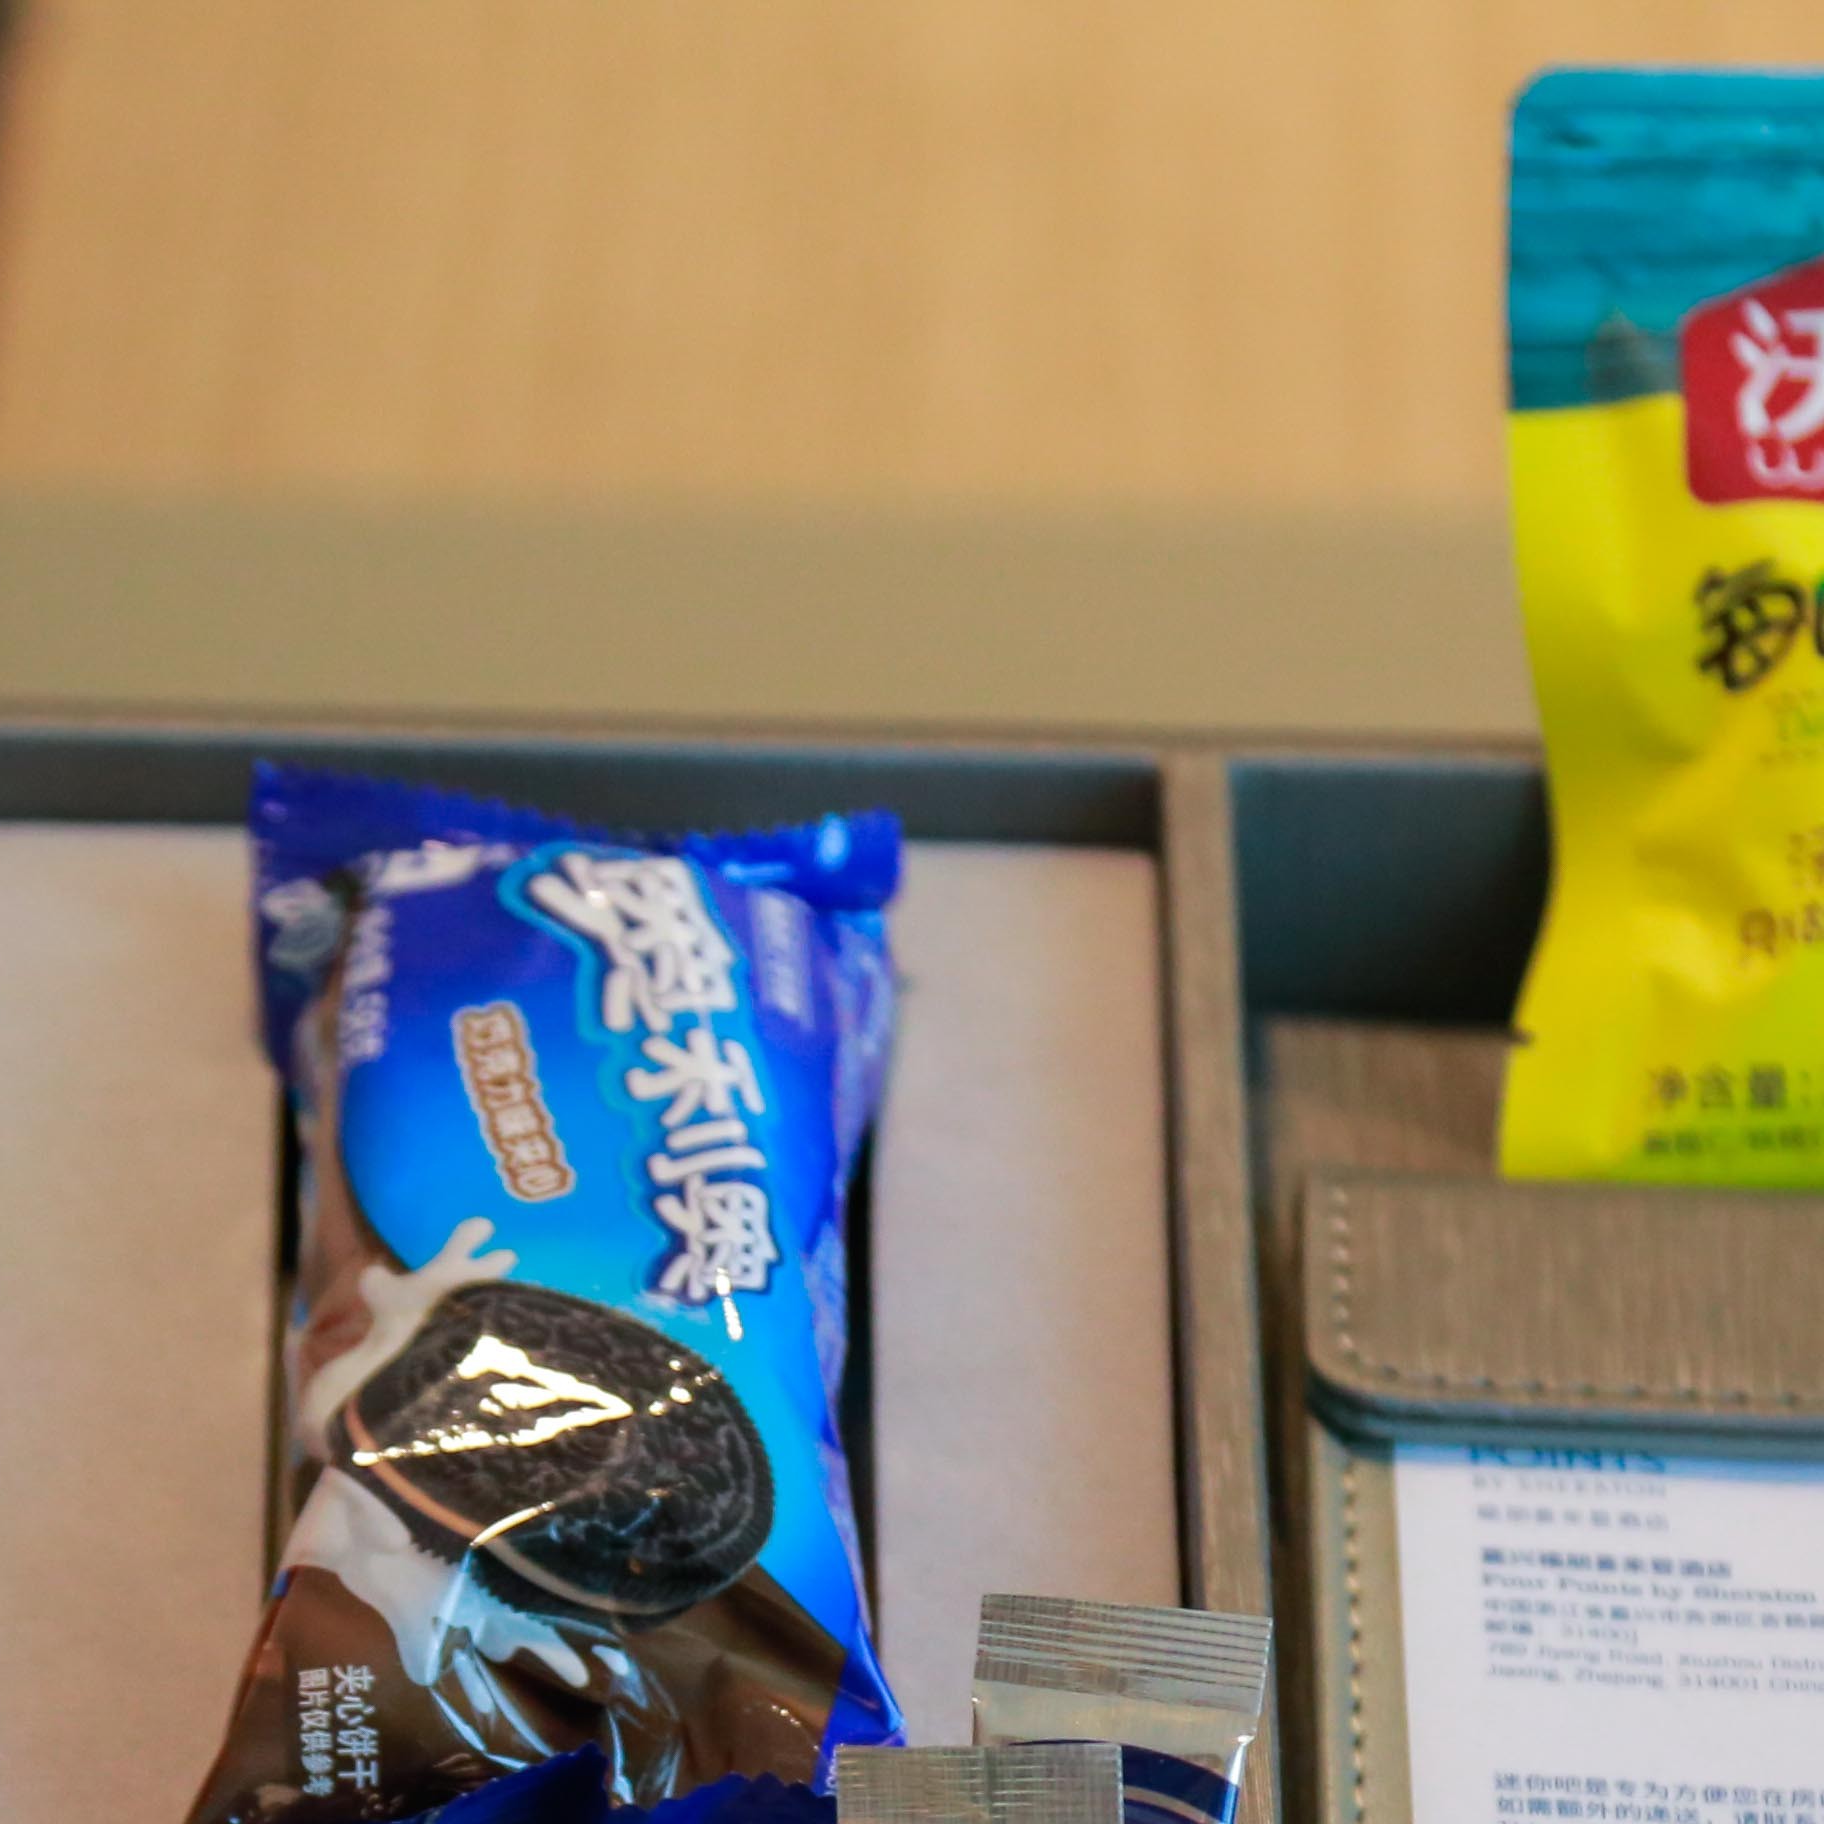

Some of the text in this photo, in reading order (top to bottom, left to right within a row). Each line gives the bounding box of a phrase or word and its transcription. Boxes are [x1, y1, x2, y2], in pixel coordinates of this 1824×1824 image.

[529, 851, 778, 1302] 奥利奥
[298, 1667, 334, 1797] 图片仅供参考
[332, 1664, 379, 1790] 夹心饼干
